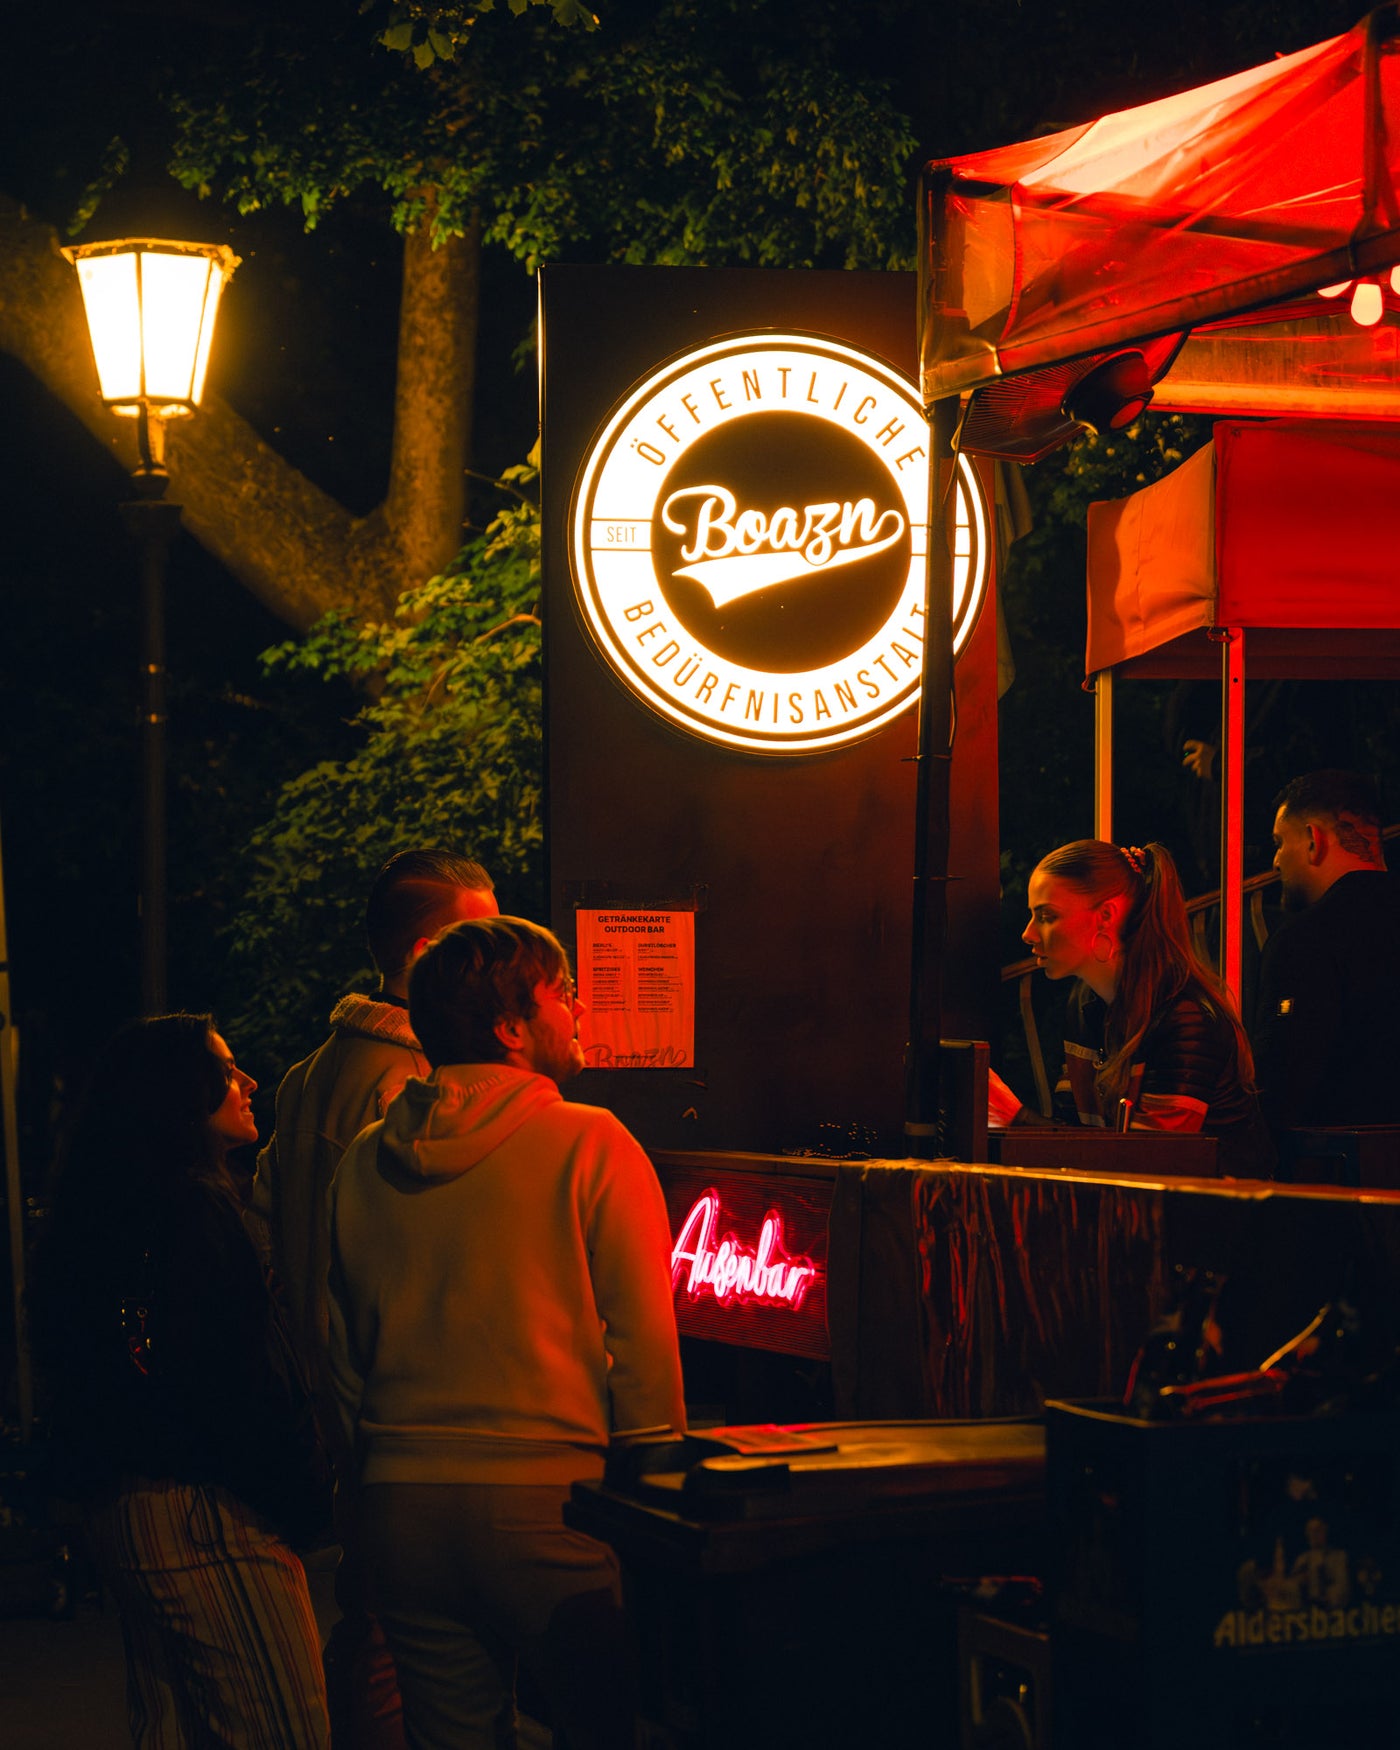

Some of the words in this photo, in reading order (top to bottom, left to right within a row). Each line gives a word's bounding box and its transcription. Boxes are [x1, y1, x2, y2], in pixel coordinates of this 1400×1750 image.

[629, 367, 926, 471] ÖFFENTLICHE
[606, 526, 637, 543] SEIT
[661, 484, 905, 566] Boazn
[598, 914, 671, 923] GETRÄNKEKARTE
[604, 925, 647, 933] OUTDOOR
[647, 925, 665, 933] BAR
[1213, 1602, 1400, 1648] Aldersbache
